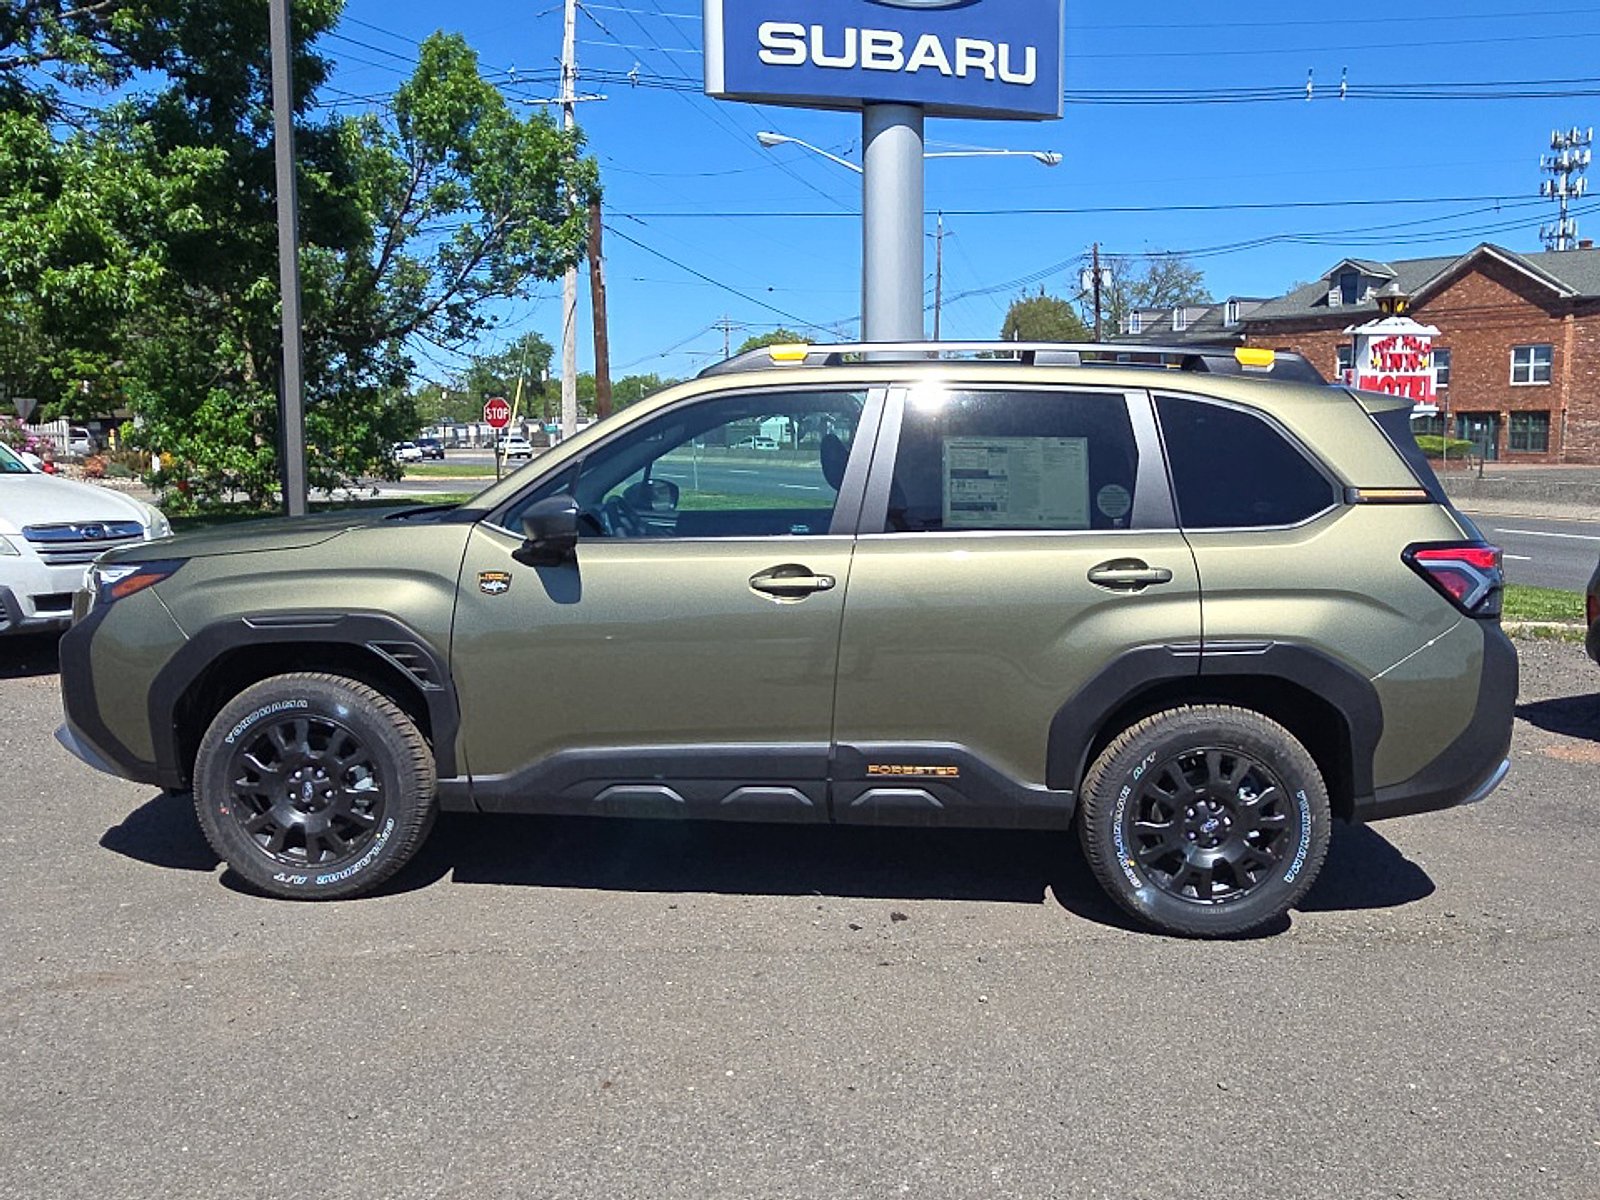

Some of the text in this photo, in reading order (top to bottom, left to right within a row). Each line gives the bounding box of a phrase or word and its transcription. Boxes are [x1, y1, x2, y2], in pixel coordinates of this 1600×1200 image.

[757, 21, 1038, 86] SUBARU
[1379, 353, 1420, 372] INN
[1359, 375, 1436, 404] MOTEL
[486, 407, 509, 420] STOP
[867, 764, 959, 775] FORESTER
